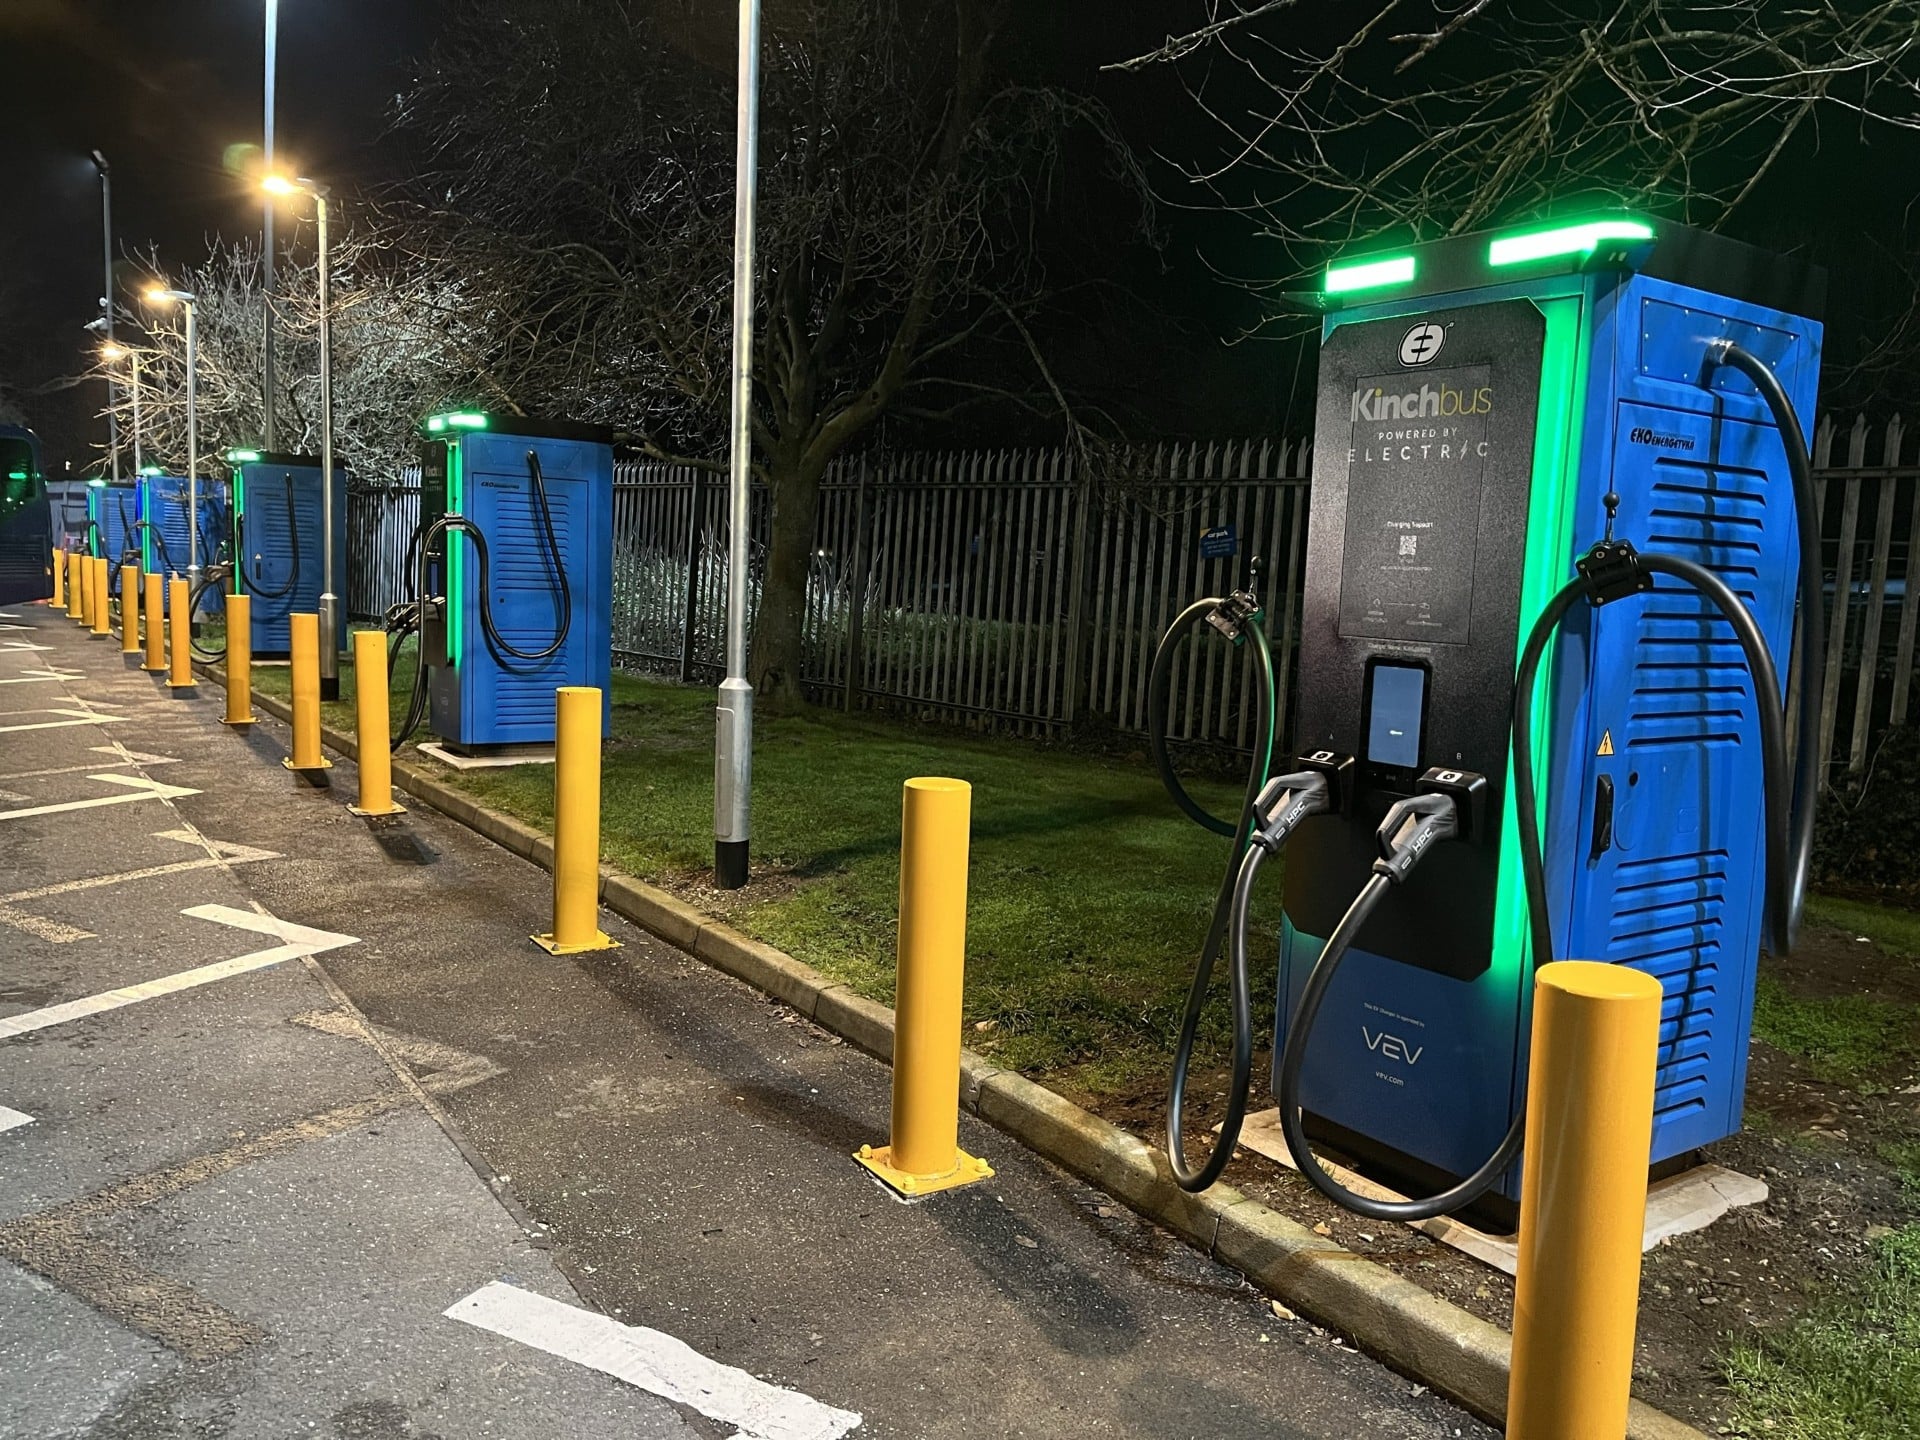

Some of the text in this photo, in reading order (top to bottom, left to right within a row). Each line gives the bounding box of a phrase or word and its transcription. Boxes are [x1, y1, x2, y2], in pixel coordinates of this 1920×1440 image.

[1350, 383, 1493, 422] Kinchbus
[1378, 427, 1458, 441] POWERED BY
[1286, 801, 1306, 824] HPC
[1412, 827, 1433, 852] HPC
[1362, 1026, 1423, 1064] VEV
[1375, 1071, 1404, 1087] vev.com
